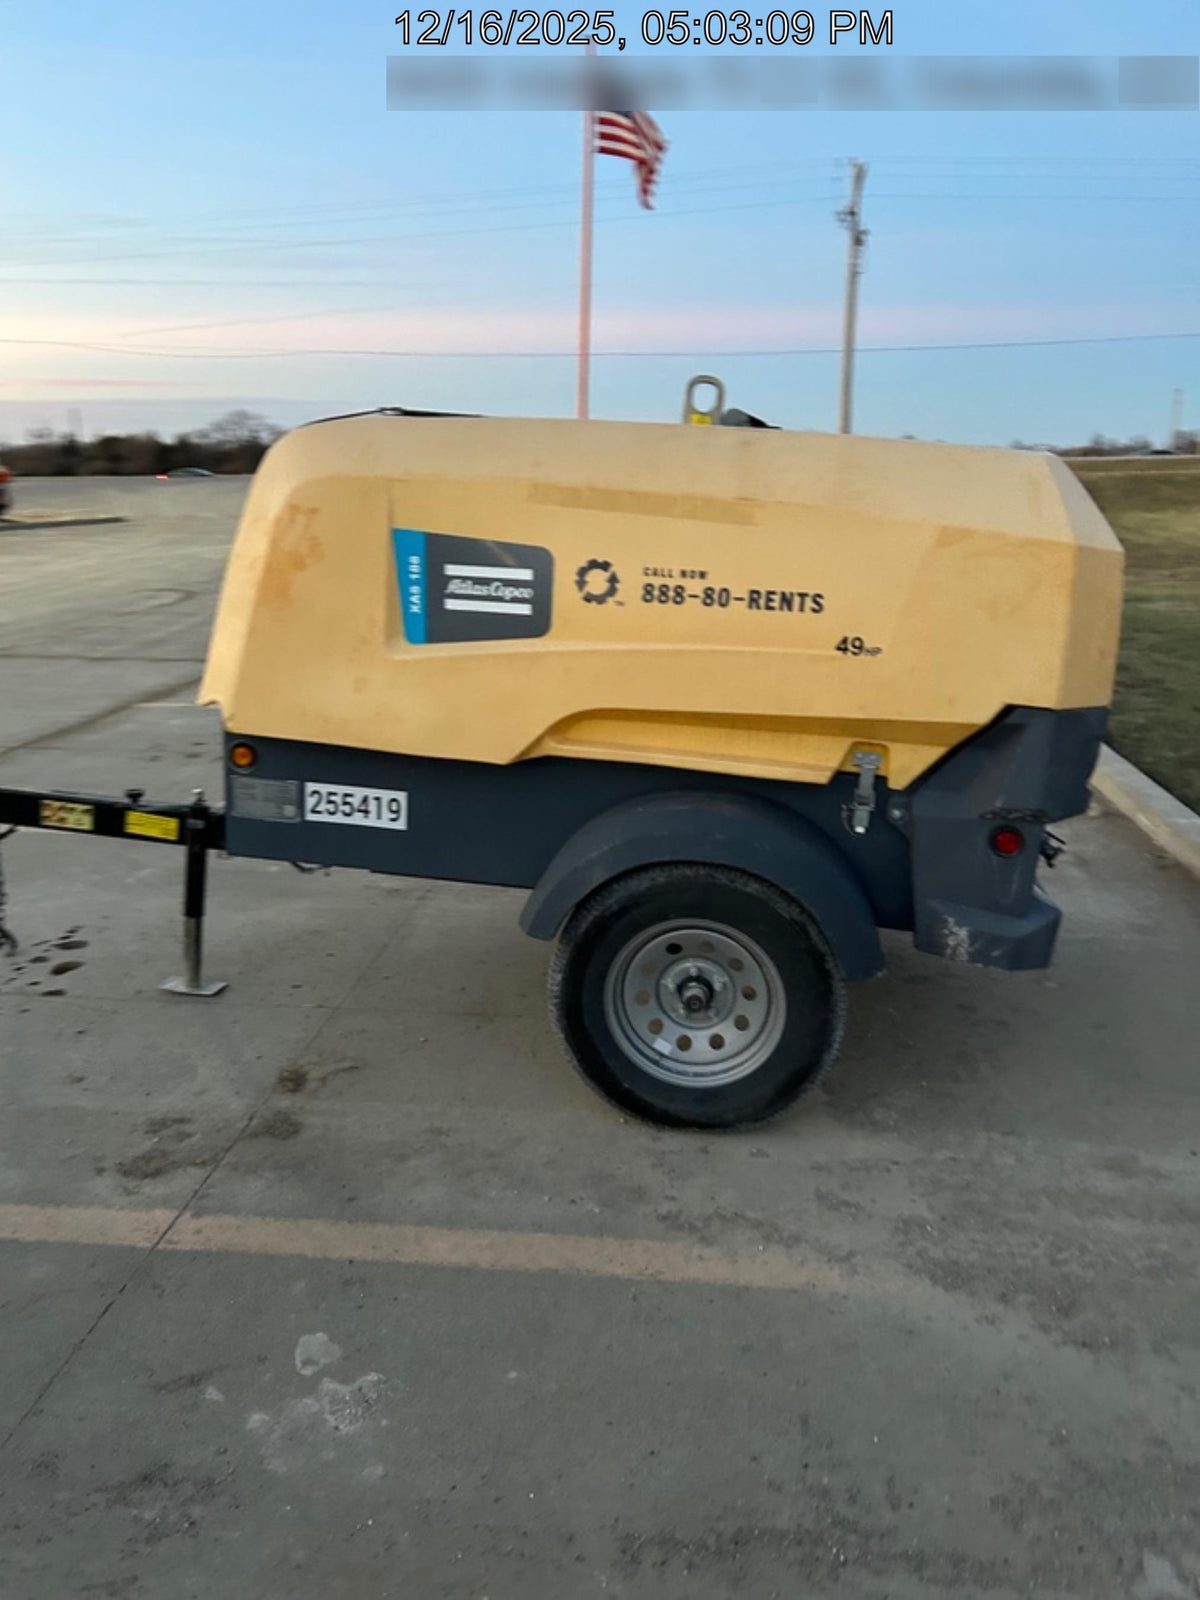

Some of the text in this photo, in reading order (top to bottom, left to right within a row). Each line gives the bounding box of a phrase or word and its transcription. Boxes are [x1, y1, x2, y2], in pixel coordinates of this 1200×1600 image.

[643, 567, 708, 580] CALL NOW
[642, 583, 825, 613] 888-80-RENTS
[309, 790, 402, 822] 255419
